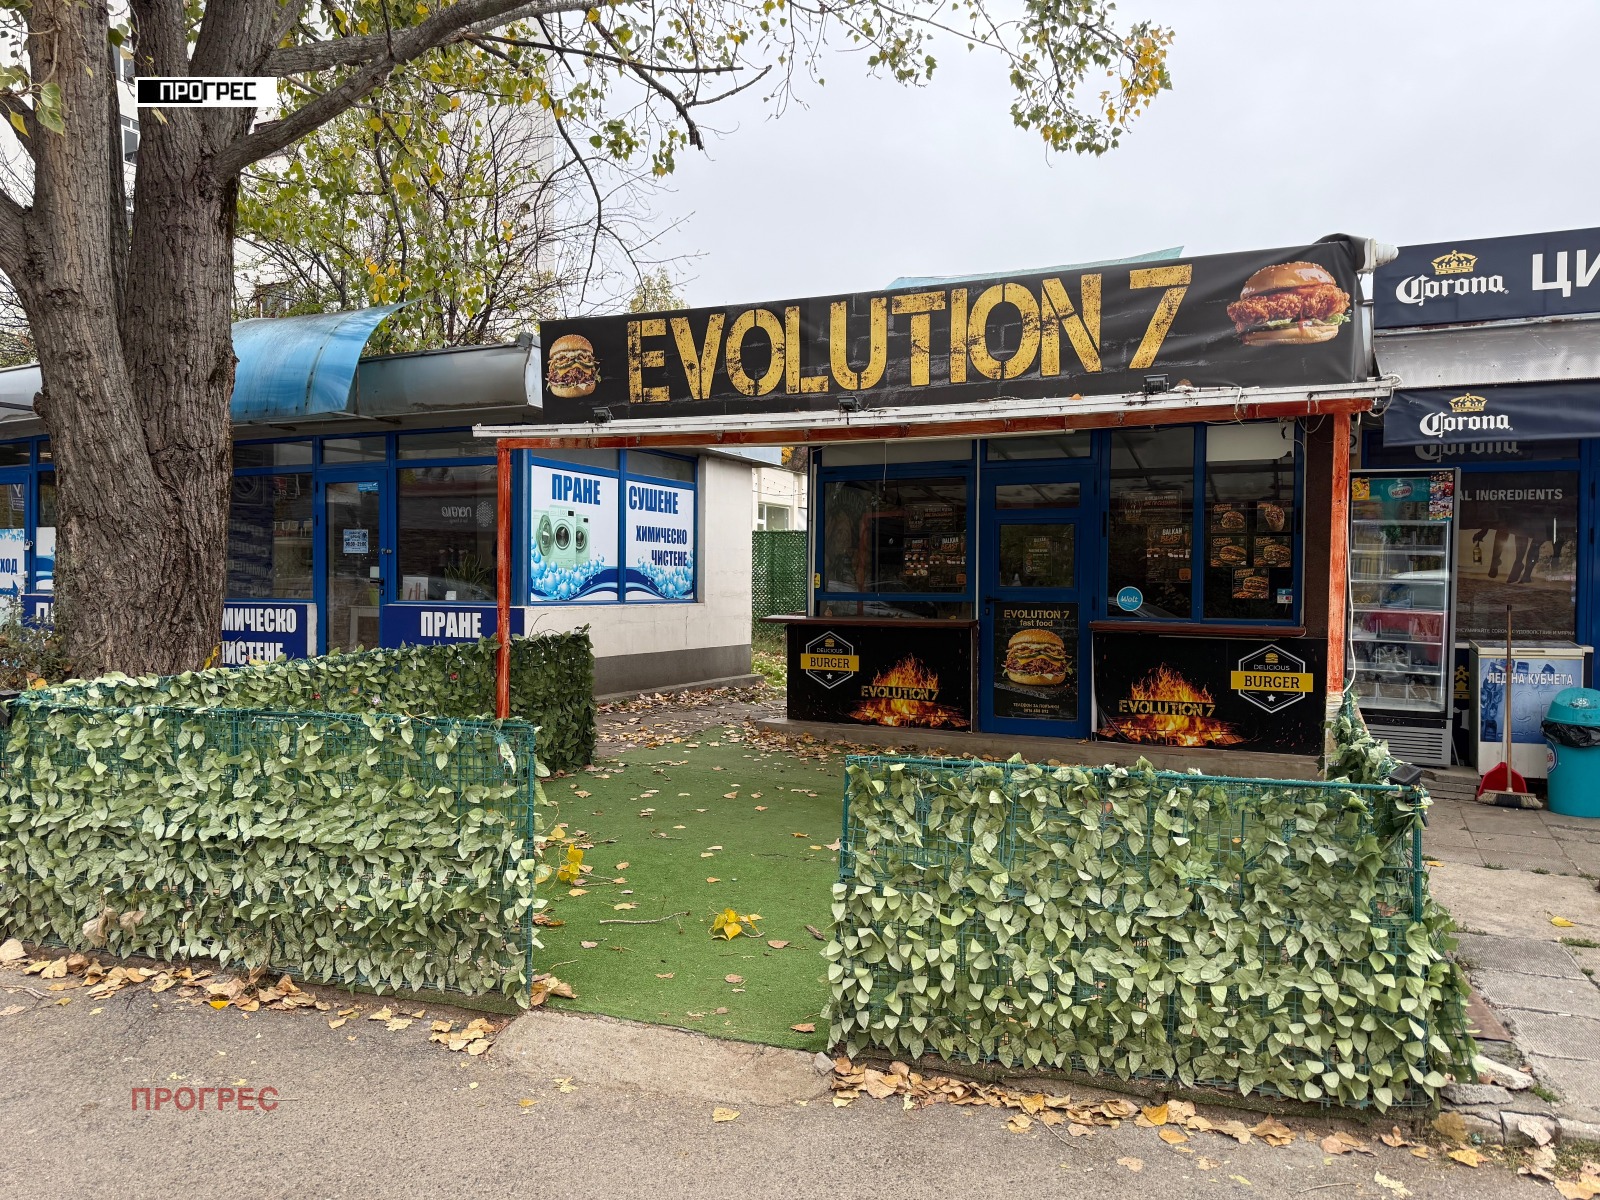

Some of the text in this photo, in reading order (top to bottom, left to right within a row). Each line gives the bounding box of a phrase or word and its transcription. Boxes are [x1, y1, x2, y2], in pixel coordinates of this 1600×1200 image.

[1395, 274, 1508, 306] Corona
[627, 263, 1193, 404] EVOLUTION 7
[1419, 411, 1511, 438] Corona
[551, 473, 601, 505] ПРАНЕ
[1459, 488, 1563, 501] AL INGREDIENTS
[628, 485, 679, 515] СУШЕНЕ
[635, 525, 688, 545] ХИМИЧЕСКО
[651, 549, 688, 567] ЧИСТЕНЕ
[1120, 595, 1139, 603] Wolt
[221, 608, 297, 633] МИЧЕСКО
[1003, 609, 1070, 619] EVOLUTION 7
[420, 611, 482, 638] ПРАНЕ
[810, 657, 850, 669] BURGER
[1244, 675, 1300, 688] BURGER
[1488, 672, 1573, 685] ЛЕД НА КУБЧЕТА
[860, 685, 940, 701] EVOLUTION 7
[1118, 699, 1216, 718] EVOLUTION 7
